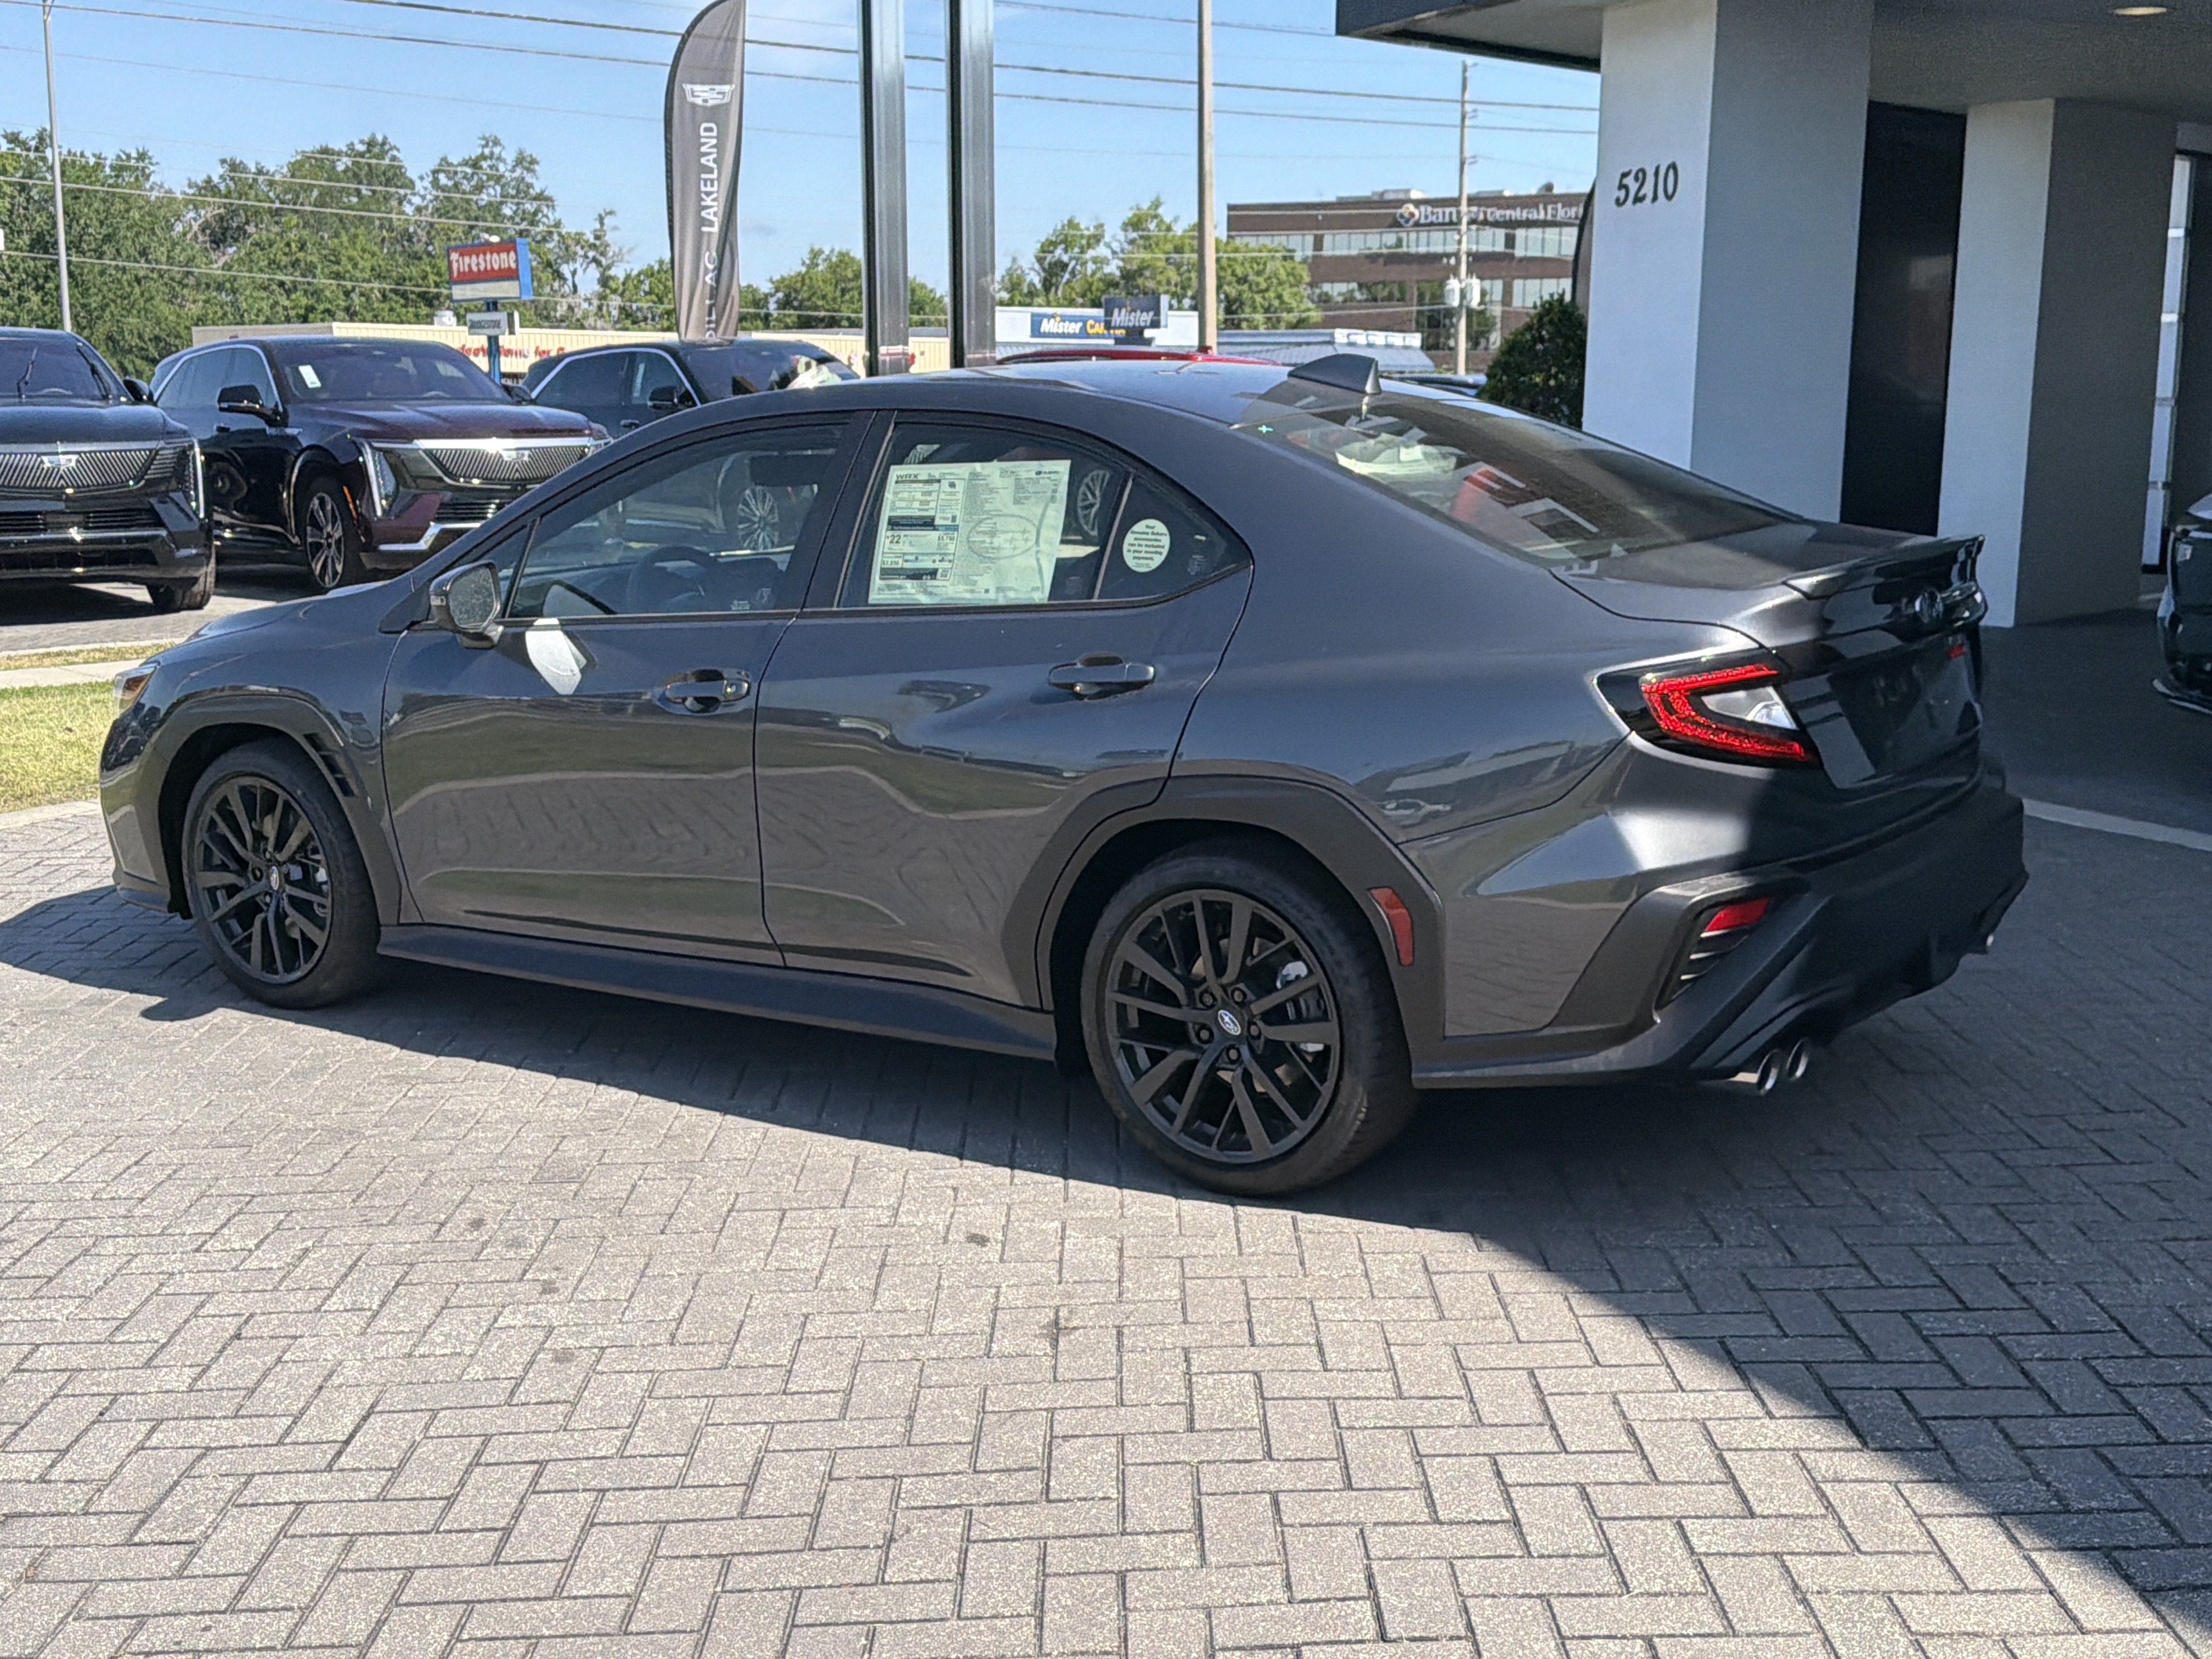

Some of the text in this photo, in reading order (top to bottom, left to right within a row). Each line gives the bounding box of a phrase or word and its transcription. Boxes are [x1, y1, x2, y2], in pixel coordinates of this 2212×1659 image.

[700, 122, 718, 233] LAKELAND
[1615, 161, 1679, 207] 5210
[450, 250, 517, 278] Firestone
[1040, 315, 1083, 334] Mister
[1111, 306, 1154, 327] Mister
[889, 534, 901, 544] 22
